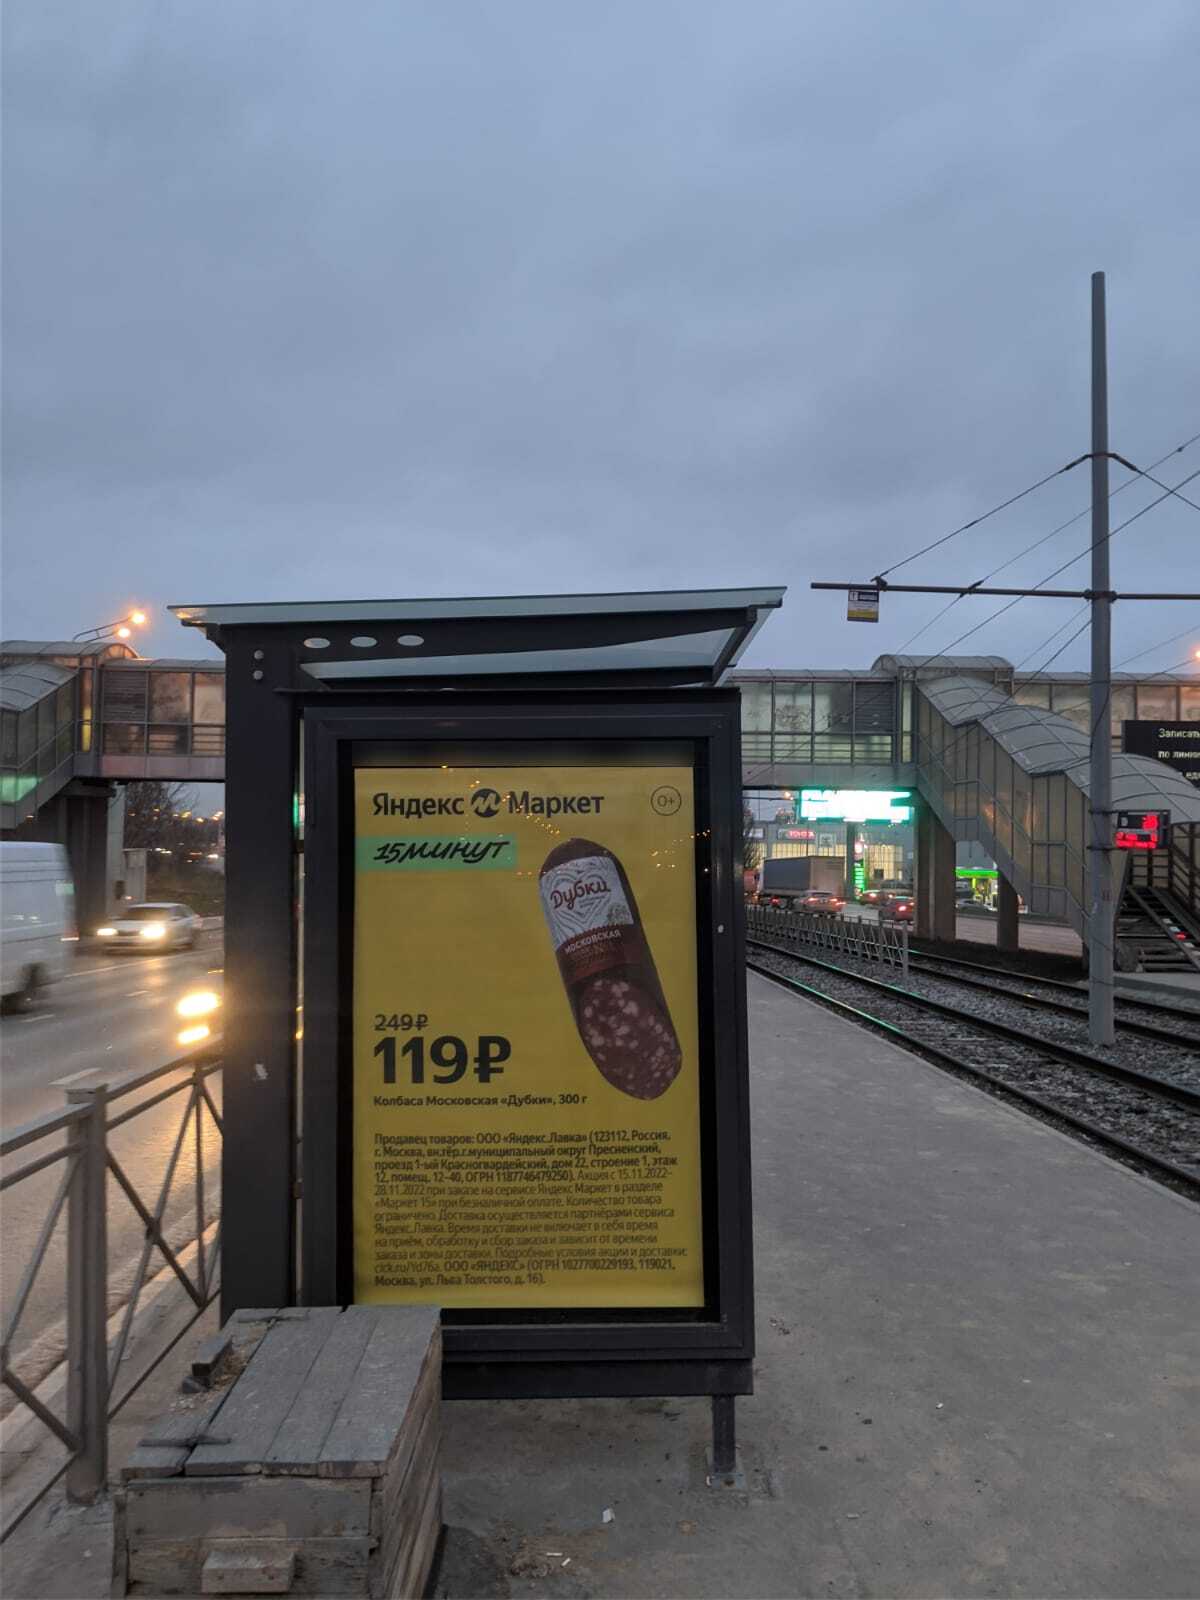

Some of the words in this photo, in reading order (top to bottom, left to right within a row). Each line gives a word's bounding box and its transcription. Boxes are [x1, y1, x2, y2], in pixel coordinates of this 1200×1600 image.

[373, 792, 464, 818] Яндекс
[508, 790, 604, 818] Маркет
[657, 795, 675, 807] 0+
[550, 879, 611, 910] Дубки
[564, 928, 622, 955] МОСКОВСКАЯ
[373, 1035, 511, 1084] 119₽
[374, 1096, 423, 1106] Колбаса
[426, 1096, 498, 1106] Московская
[500, 1094, 557, 1108] «Дубки»,
[559, 1094, 579, 1104] 300
[582, 1096, 587, 1104] г
[375, 1133, 427, 1145] Продавец
[430, 1136, 475, 1145] товаров:
[476, 1133, 502, 1144] ООО
[384, 1147, 426, 1158] Москва,
[557, 1147, 586, 1158] округ
[589, 1142, 662, 1157] Пресненский,
[374, 1161, 413, 1171] проезд
[441, 1157, 550, 1171] Красногвардейский,
[552, 1160, 573, 1170] дом
[590, 1158, 640, 1168] строение
[653, 1156, 678, 1166] этаж
[466, 1171, 494, 1182] ОГРН
[577, 1170, 609, 1182] Акция
[427, 1187, 446, 1197] при
[448, 1186, 480, 1196] заказе
[482, 1186, 494, 1195] на
[496, 1186, 538, 1196] сервисе
[538, 1183, 574, 1196] Яндекс
[575, 1183, 612, 1195] Маркет
[622, 1183, 664, 1195] разделе
[374, 1196, 418, 1210] «Маркет
[438, 1198, 458, 1209] при
[459, 1196, 526, 1208] безналичной
[566, 1196, 624, 1206] Количество
[626, 1196, 662, 1206] товара
[438, 1209, 486, 1222] Доставка
[487, 1211, 568, 1222] осуществляется
[634, 1208, 674, 1219] сервиса
[448, 1222, 480, 1236] Время
[482, 1223, 528, 1234] доставки
[530, 1224, 543, 1232] не
[544, 1222, 592, 1232] включает
[602, 1220, 625, 1232] себя
[626, 1222, 658, 1232] время
[426, 1235, 479, 1248] обработку
[489, 1235, 514, 1247] сбор
[515, 1236, 548, 1246] заказа
[599, 1236, 610, 1244] от
[613, 1235, 658, 1245] времени
[375, 1252, 408, 1260] заказа
[496, 1248, 555, 1260] Подробные
[556, 1248, 596, 1260] условия
[598, 1248, 629, 1259] акции
[444, 1260, 469, 1272] ООО
[470, 1260, 526, 1272] «ЯНДЕКС»
[528, 1258, 560, 1272] (ОГРН
[375, 1275, 418, 1287] Москва,
[418, 1277, 434, 1288] ул.
[436, 1274, 462, 1286] Льва
[464, 1274, 514, 1286] Толстого,
